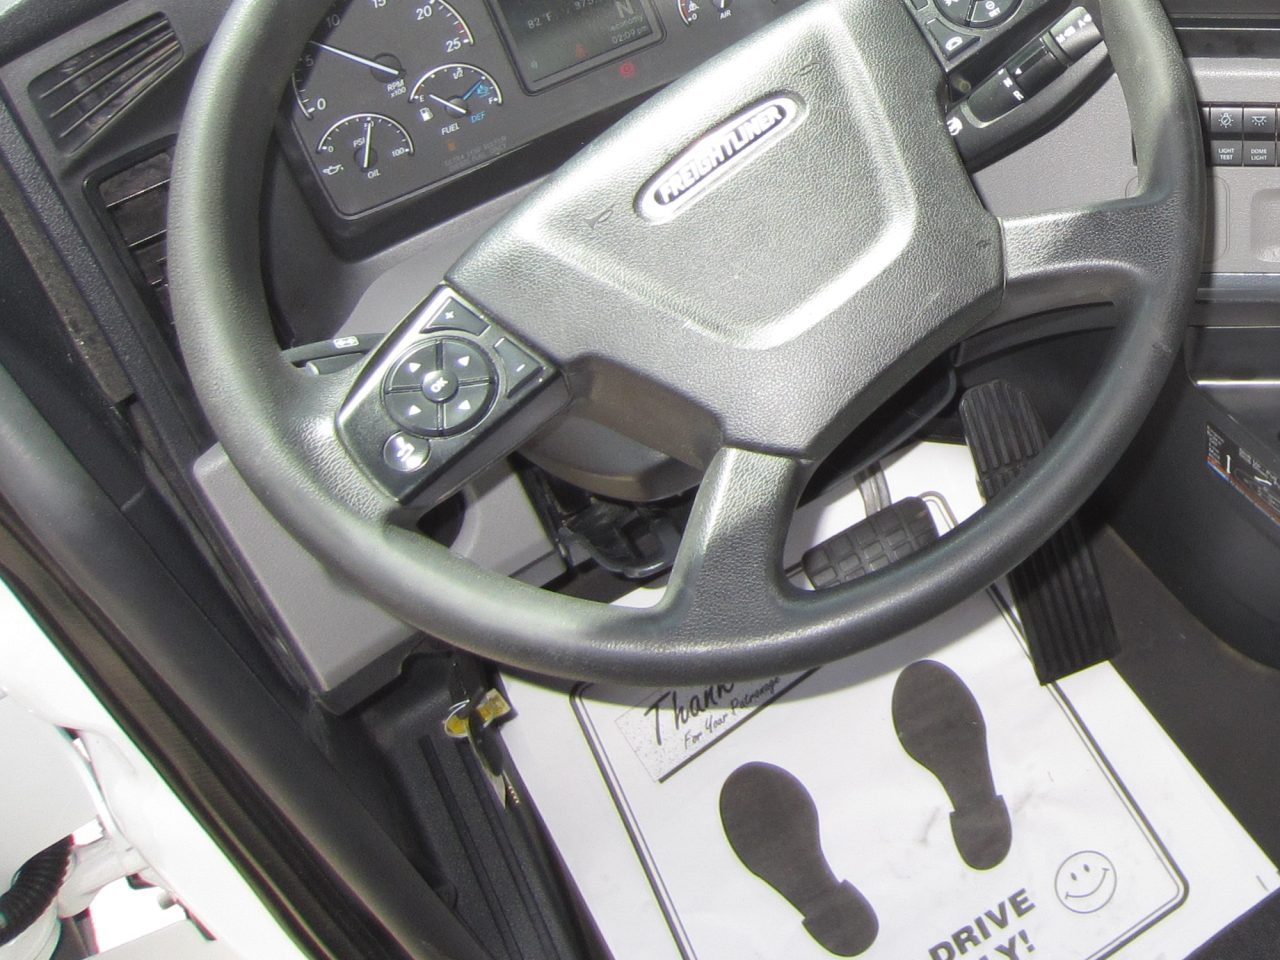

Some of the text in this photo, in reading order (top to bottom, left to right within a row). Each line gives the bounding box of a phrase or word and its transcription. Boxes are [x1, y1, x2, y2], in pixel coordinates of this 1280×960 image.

[416, 5, 432, 21] 20
[720, 11, 732, 20] AIR
[326, 14, 340, 28] 10
[446, 37, 461, 53] 25
[306, 55, 314, 67] 5
[387, 79, 404, 92] RPM
[1013, 90, 1024, 101] R
[316, 98, 327, 110] 0
[471, 111, 486, 123] DEF
[441, 122, 460, 136] FUEL
[353, 137, 365, 147] PSI
[391, 147, 405, 158] 100
[658, 105, 783, 204] FREIGHTLINER
[367, 169, 381, 179] OIL
[431, 377, 448, 392] OK
[684, 676, 781, 750] For Your Patronage
[928, 888, 1036, 960] DRIVE
